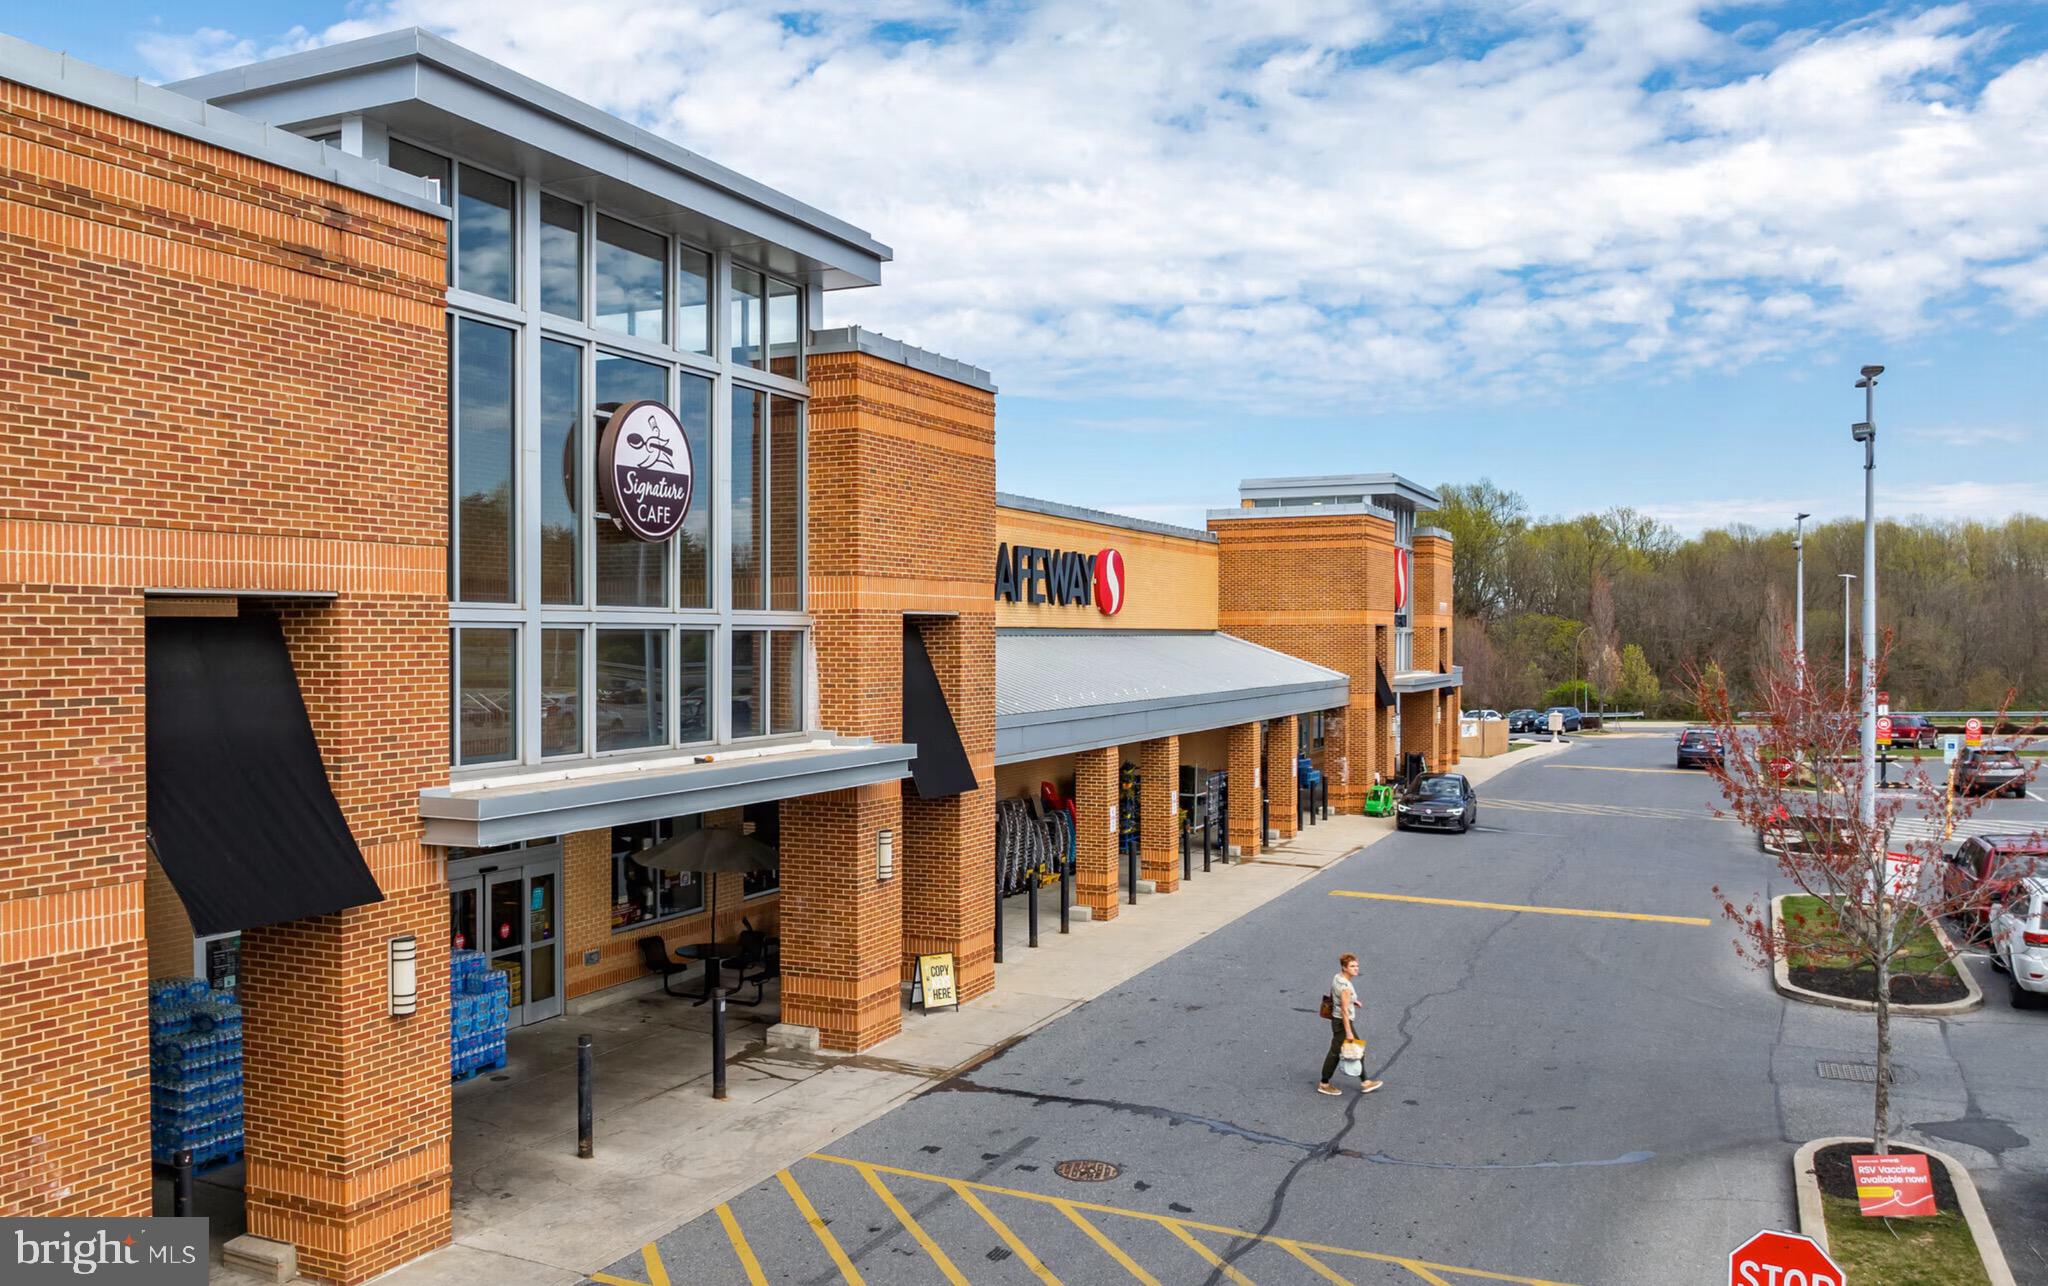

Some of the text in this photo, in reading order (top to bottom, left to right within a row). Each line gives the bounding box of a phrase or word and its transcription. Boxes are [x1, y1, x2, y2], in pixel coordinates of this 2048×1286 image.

[624, 471, 684, 503] Signature
[637, 504, 670, 524] CAFE
[994, 542, 1097, 606] AFEWAY
[931, 965, 949, 977] COPY
[933, 988, 952, 1000] HERE
[1858, 1166, 1915, 1174] RSV Vaccine
[1860, 1175, 1903, 1184] available
